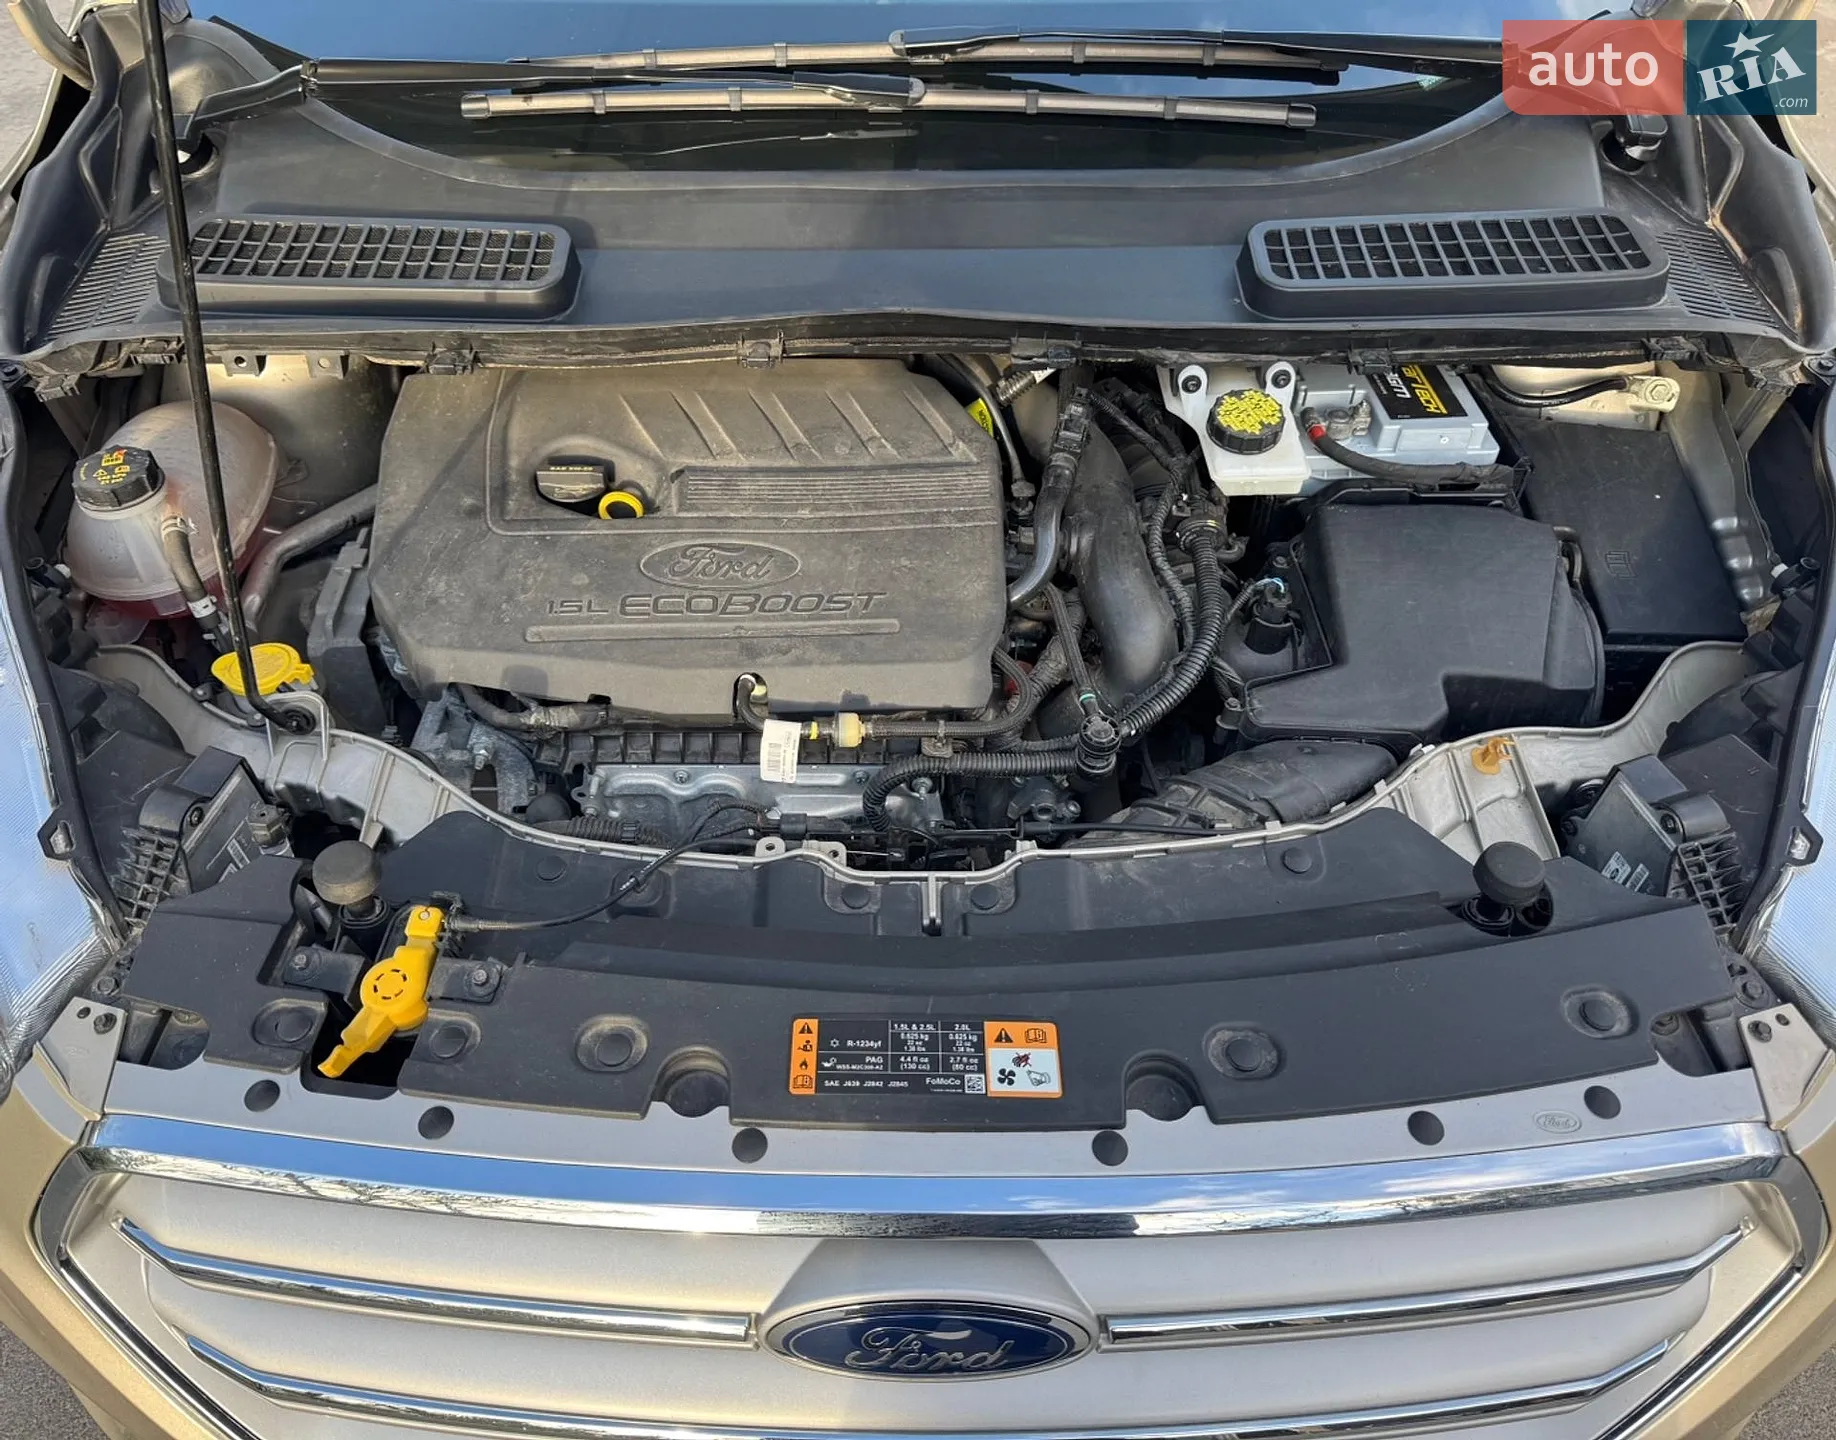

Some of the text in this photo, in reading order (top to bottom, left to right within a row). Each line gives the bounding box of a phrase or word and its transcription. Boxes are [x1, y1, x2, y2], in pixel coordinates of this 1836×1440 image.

[667, 542, 775, 583] Ford
[547, 599, 609, 616] 1.5L
[920, 1033, 929, 1041] kg
[968, 1034, 978, 1042] kg
[846, 1040, 882, 1049] R-1234yf
[843, 1326, 1014, 1371] Ford
